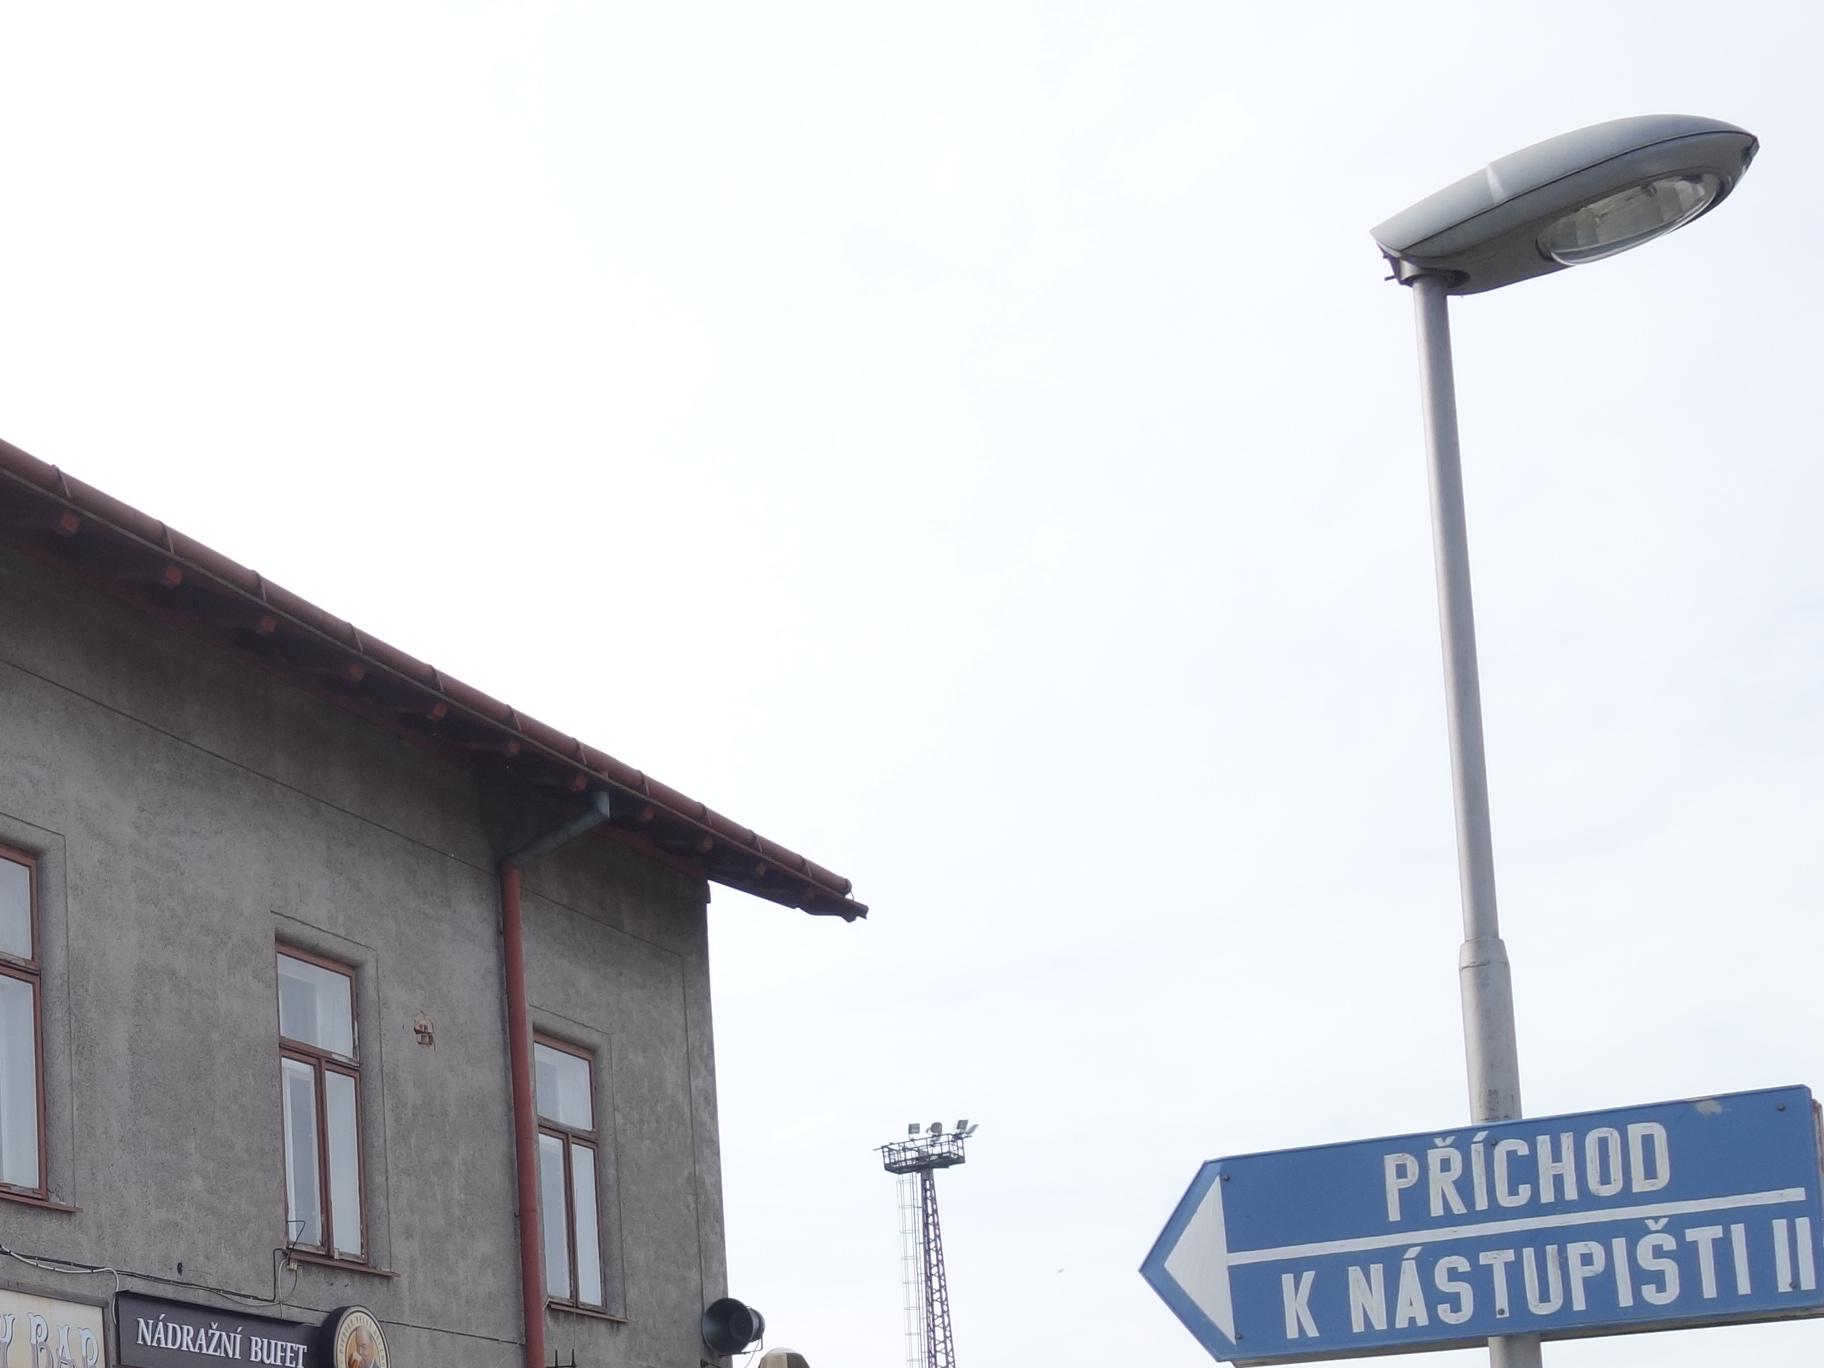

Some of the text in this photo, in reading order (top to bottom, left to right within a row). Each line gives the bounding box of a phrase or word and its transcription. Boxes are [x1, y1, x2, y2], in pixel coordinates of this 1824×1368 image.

[1384, 1122, 1671, 1222] PŘÍCHOD
[1281, 1216, 1817, 1339] K NÁSTUPIŠTI II
[136, 1313, 244, 1360] NÁDRAŽNÍ
